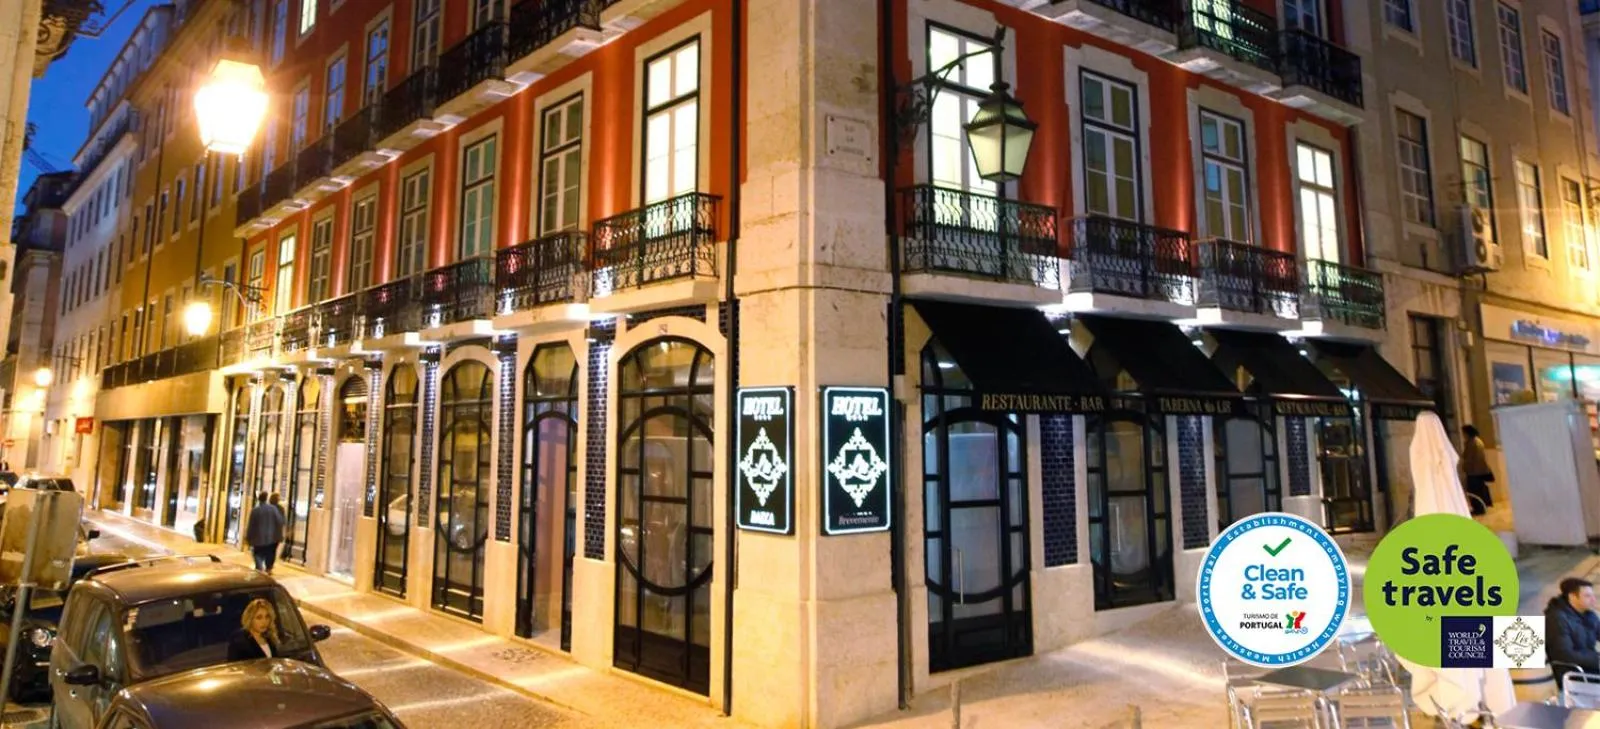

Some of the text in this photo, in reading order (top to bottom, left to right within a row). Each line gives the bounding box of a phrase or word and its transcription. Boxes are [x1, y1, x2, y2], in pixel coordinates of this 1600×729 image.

[743, 396, 784, 415] HOTEL
[831, 396, 882, 415] HOTEL
[982, 393, 1105, 412] RESTAURANTE BAR
